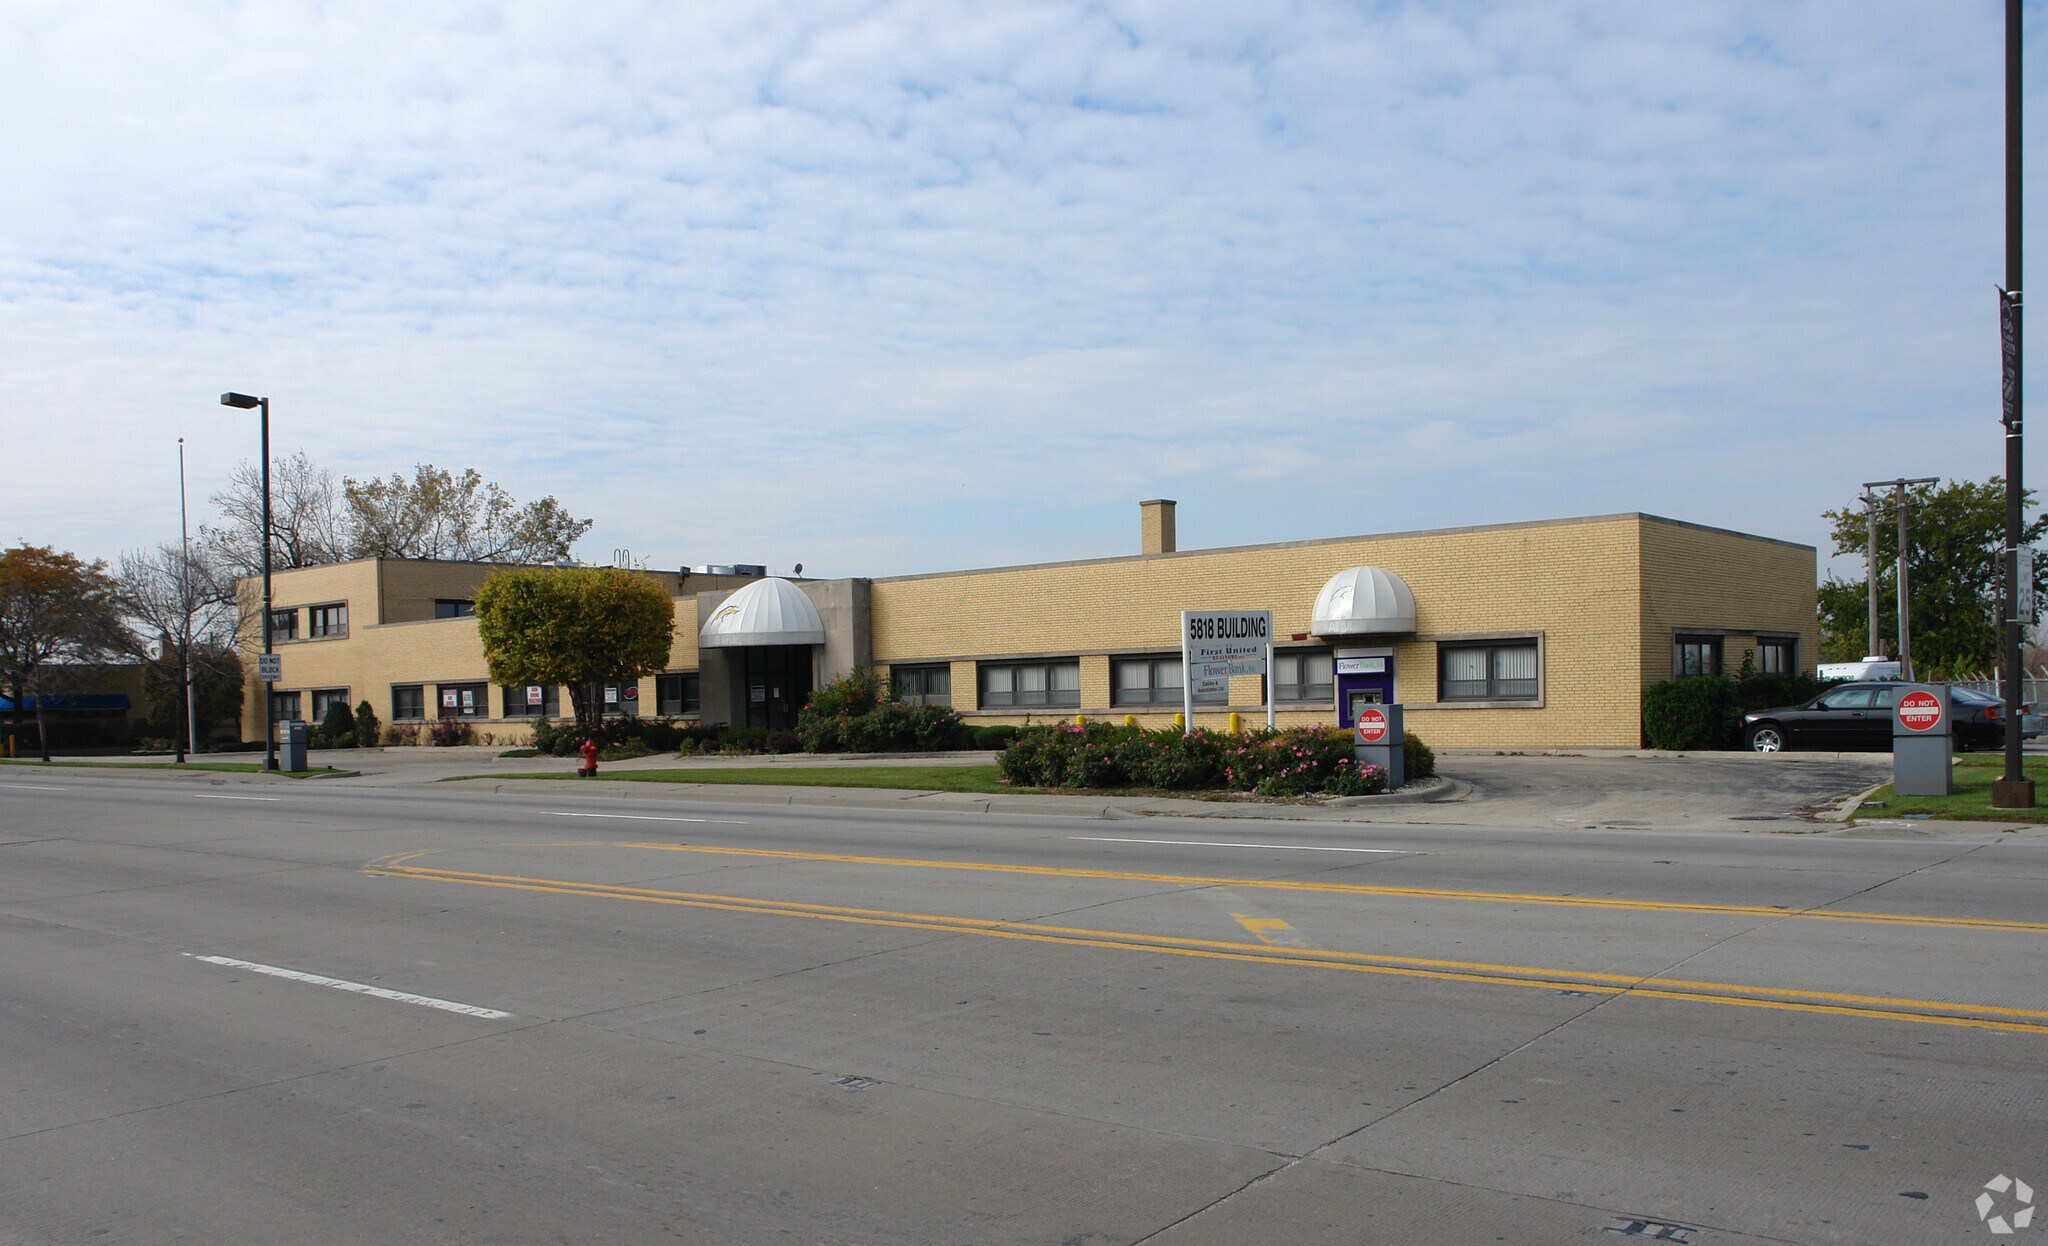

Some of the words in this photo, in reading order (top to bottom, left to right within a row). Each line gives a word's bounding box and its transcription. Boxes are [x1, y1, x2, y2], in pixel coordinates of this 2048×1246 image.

[2019, 587, 2031, 615] 25
[1190, 618, 1214, 640] 5818
[1217, 617, 1266, 639] BUILDING
[1201, 648, 1222, 656] First
[1226, 646, 1257, 654] United
[260, 657, 269, 665] DO
[270, 657, 280, 665] NOT
